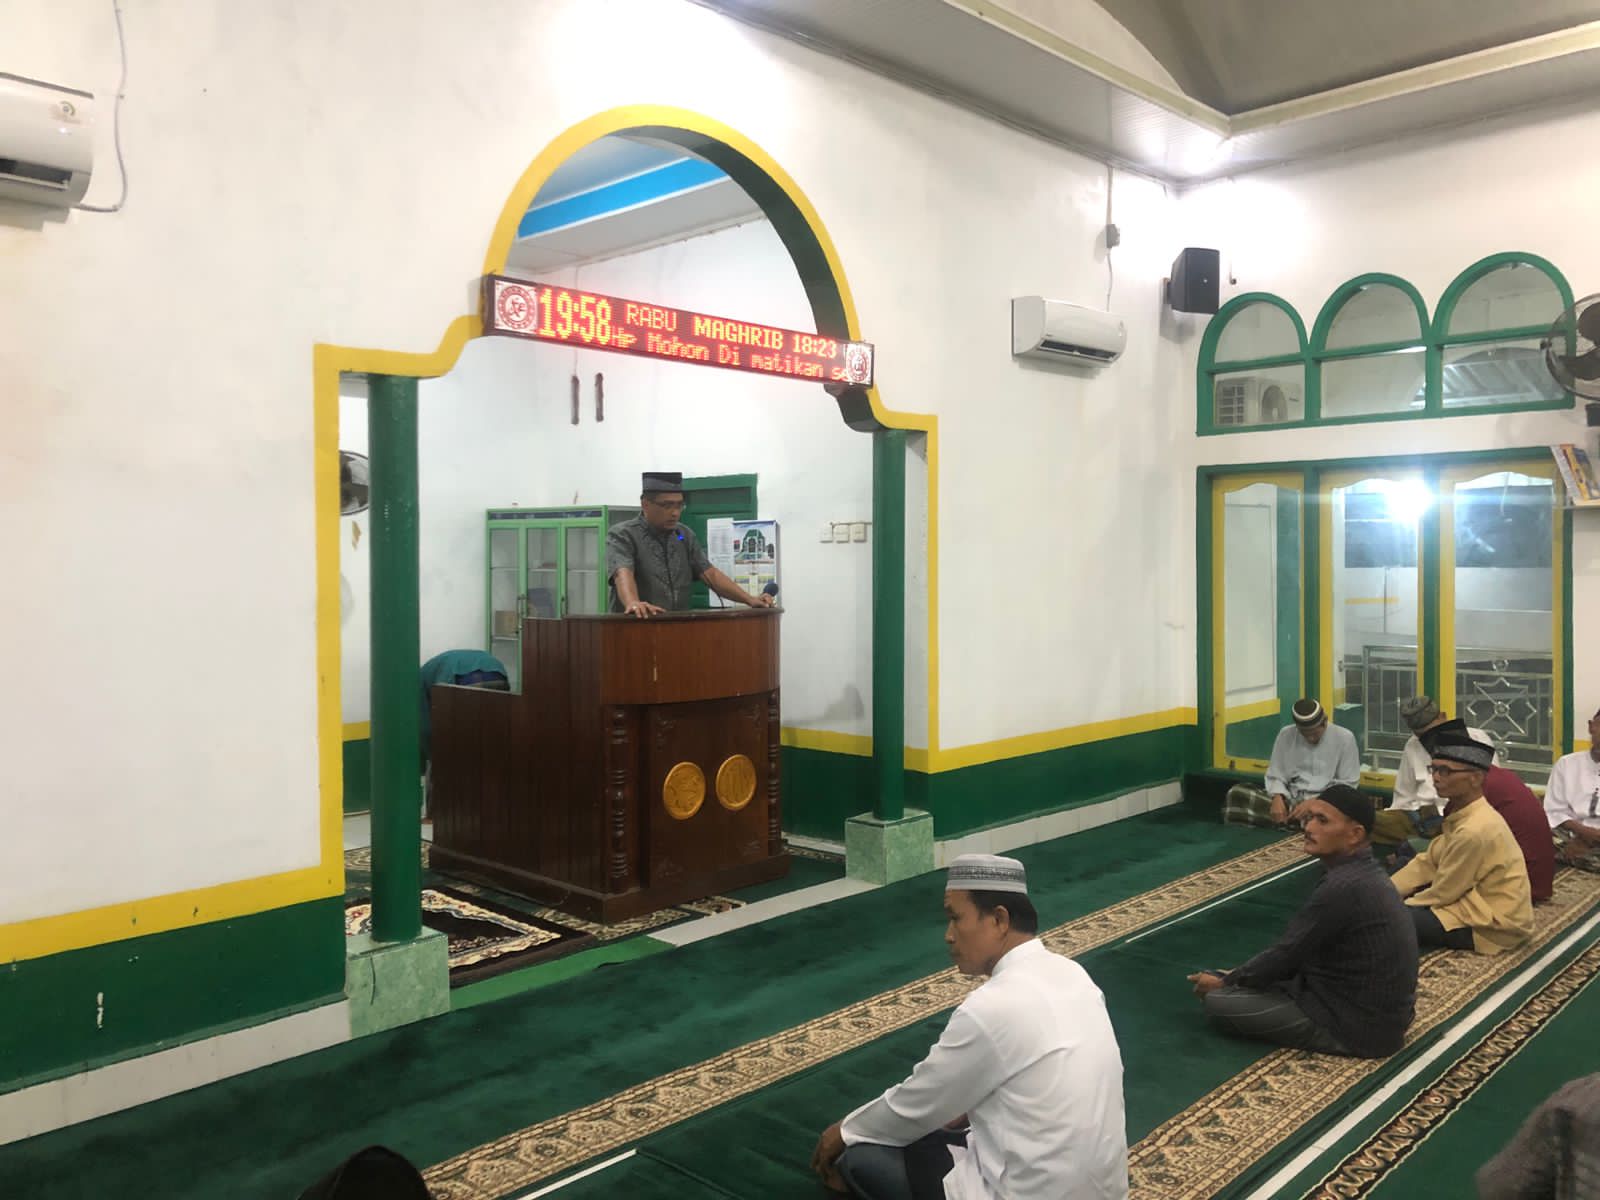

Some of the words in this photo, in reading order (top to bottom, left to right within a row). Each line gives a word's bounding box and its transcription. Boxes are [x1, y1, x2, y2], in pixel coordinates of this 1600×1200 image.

[539, 288, 612, 345] 19:58
[626, 303, 677, 332] RABU
[694, 316, 783, 350] MAGHRIB
[793, 335, 837, 359] 18:23
[647, 332, 710, 360] Mohon
[719, 344, 741, 366] Di
[751, 353, 824, 377] matikan
